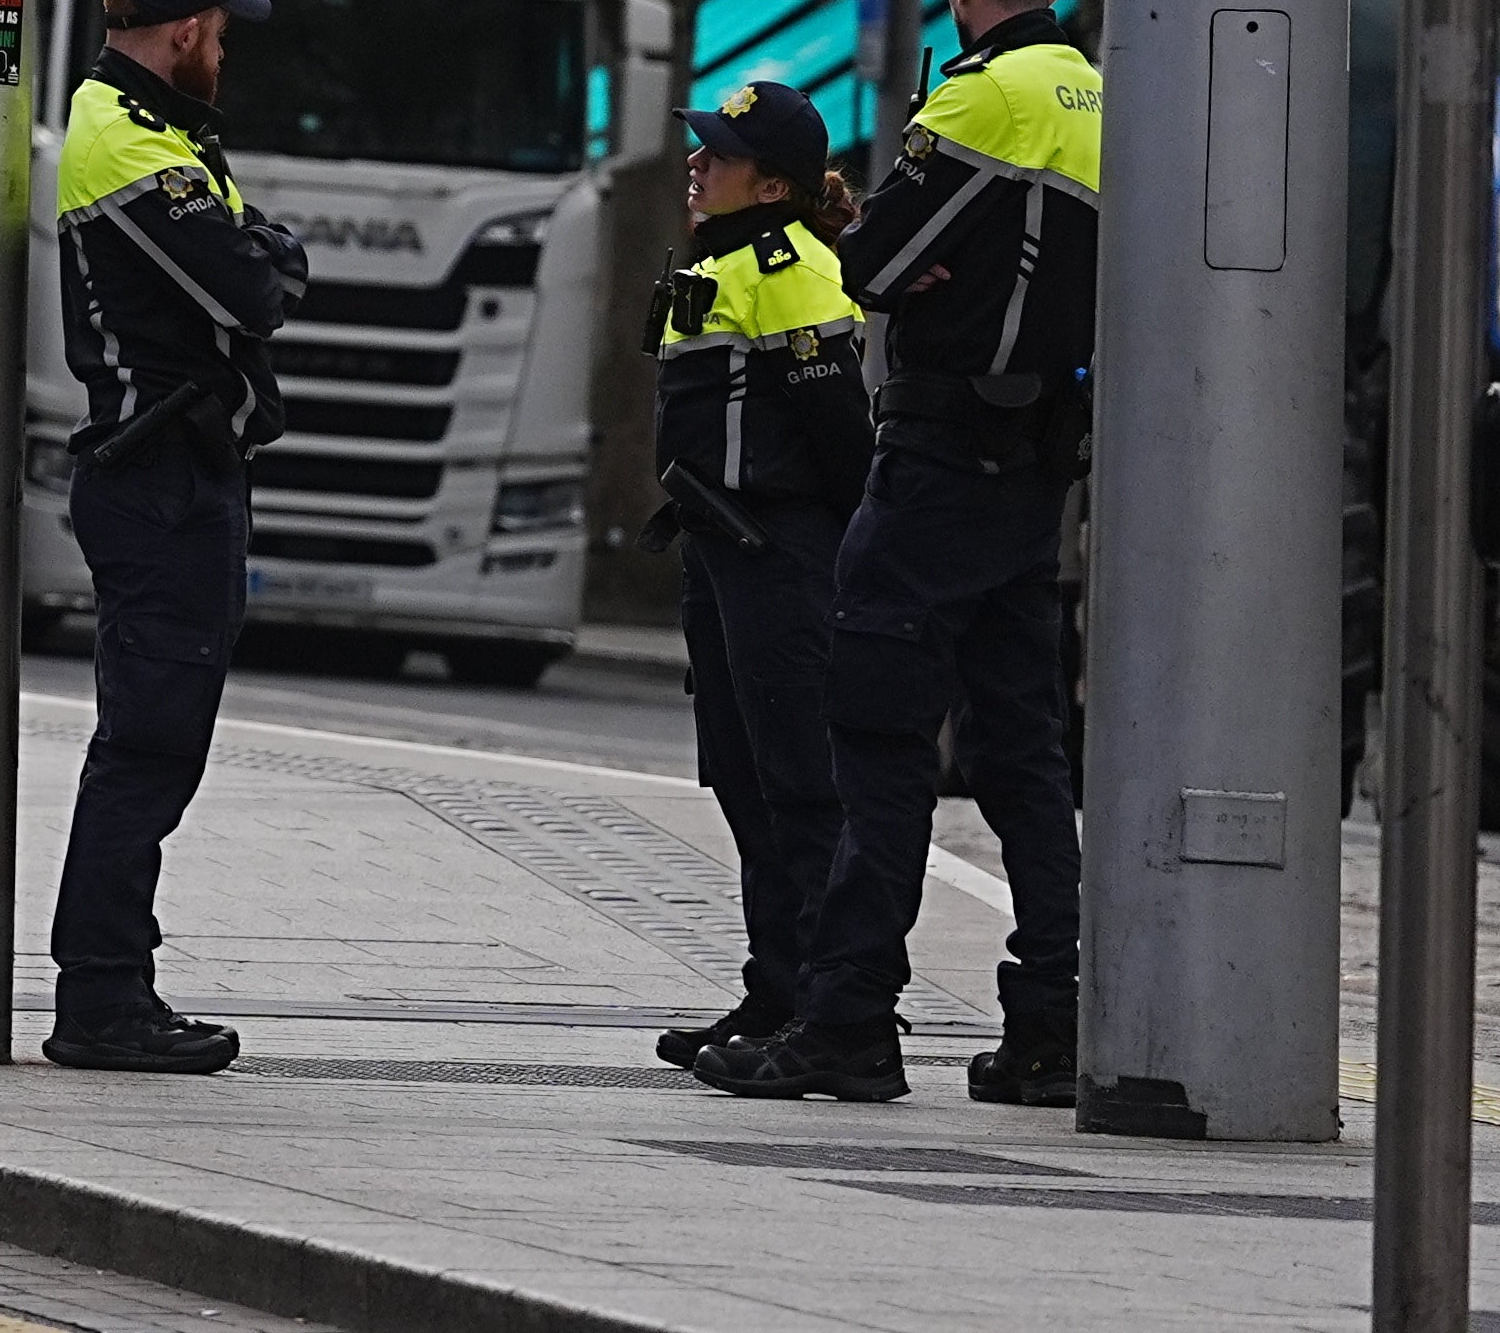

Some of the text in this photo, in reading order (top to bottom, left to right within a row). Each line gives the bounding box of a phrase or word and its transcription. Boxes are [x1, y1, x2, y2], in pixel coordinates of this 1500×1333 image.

[6, 11, 19, 25] AS
[1055, 85, 1103, 113] GAR
[168, 194, 217, 222] GRDA
[270, 211, 426, 254] CANIA
[787, 362, 842, 384] GRDA
